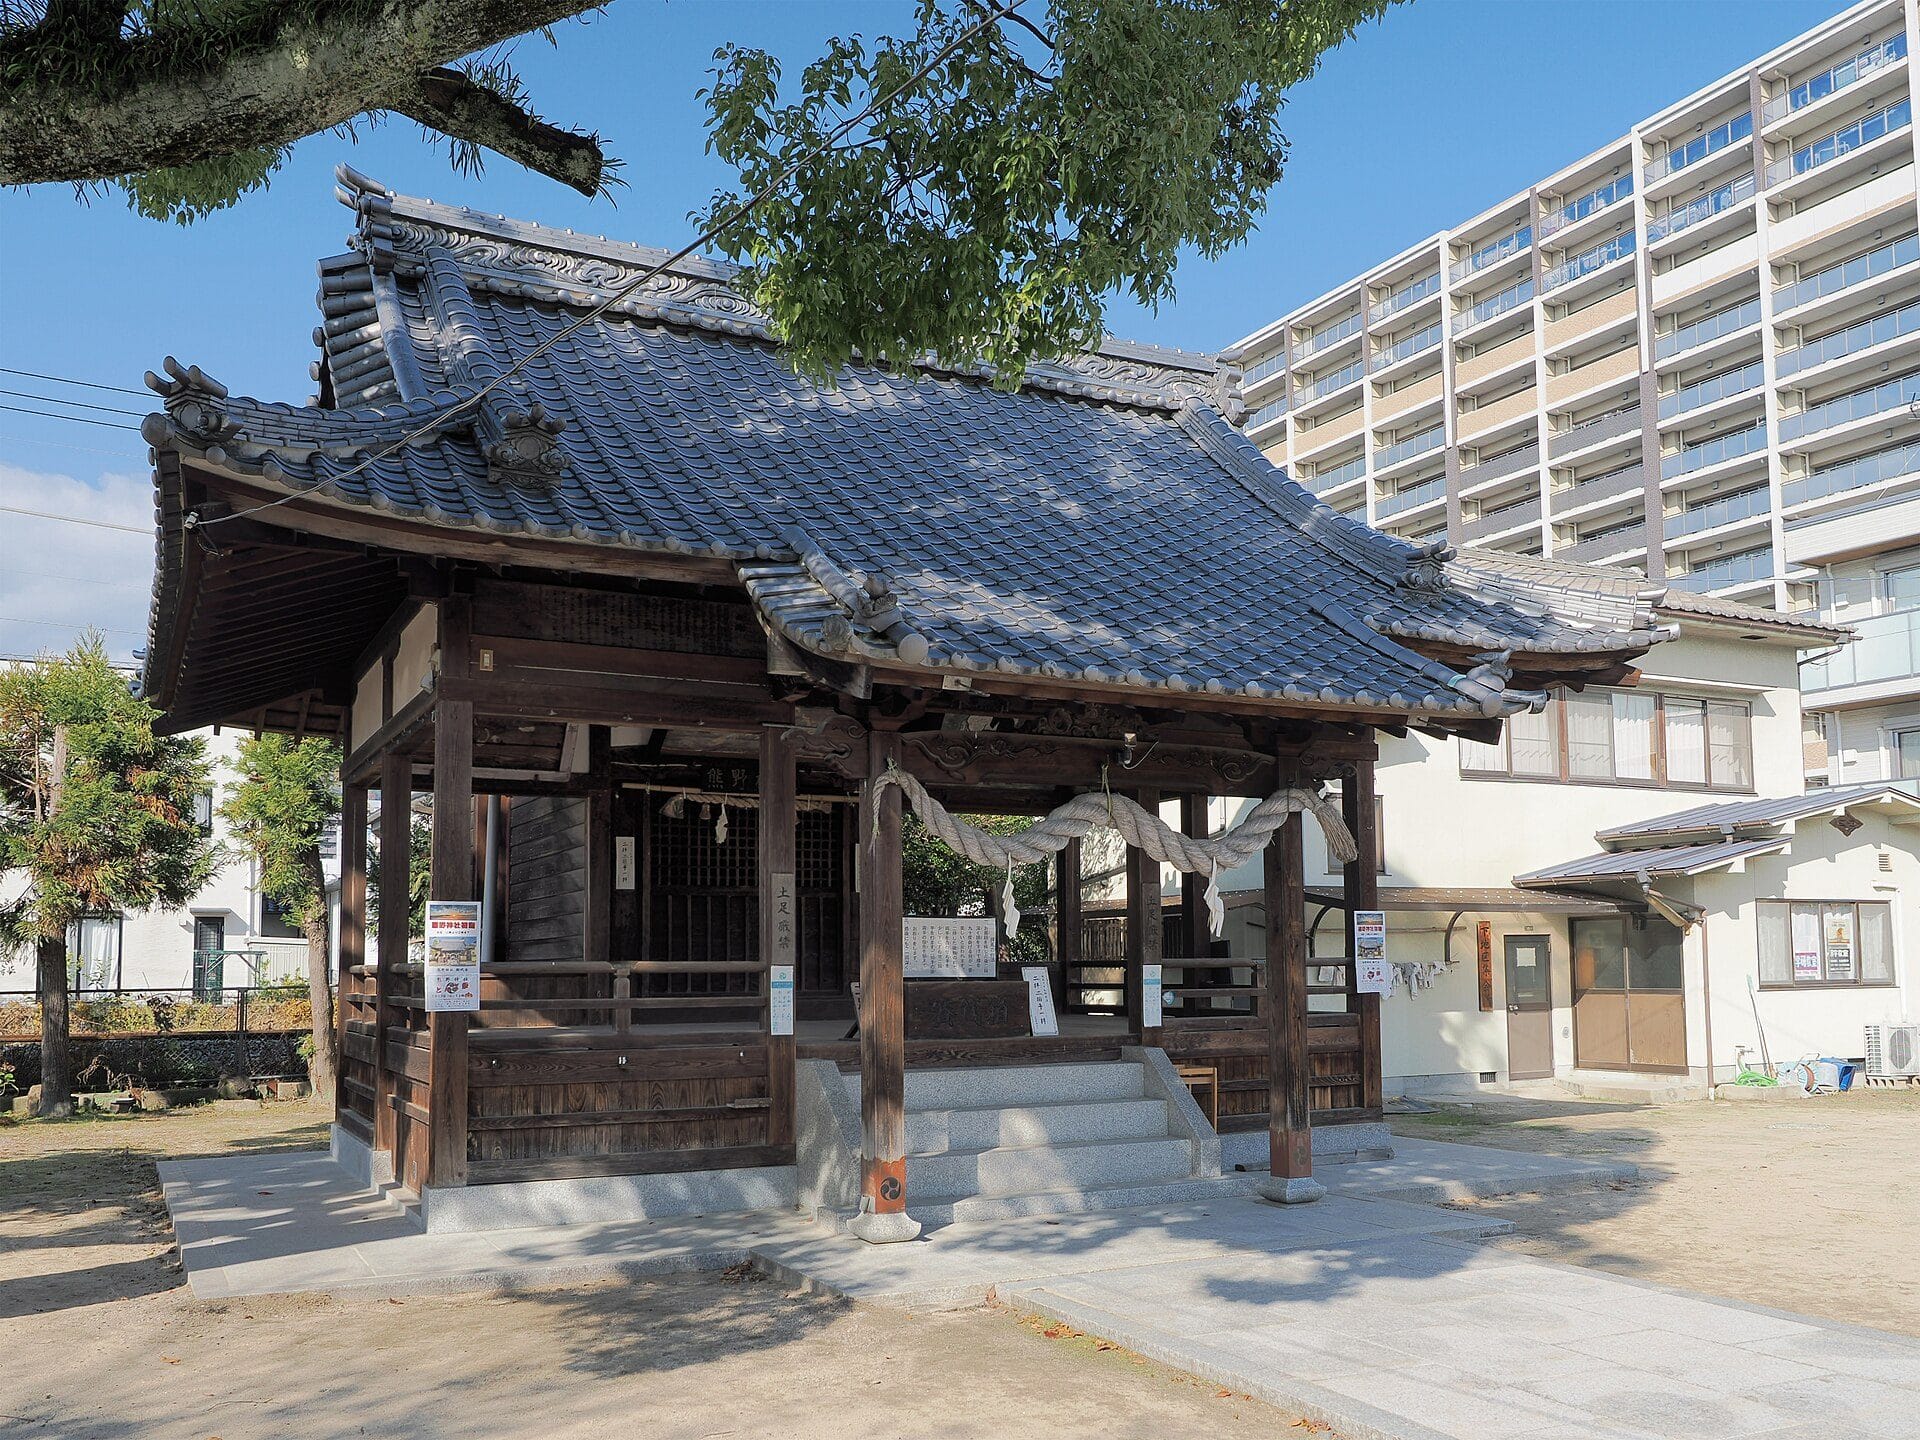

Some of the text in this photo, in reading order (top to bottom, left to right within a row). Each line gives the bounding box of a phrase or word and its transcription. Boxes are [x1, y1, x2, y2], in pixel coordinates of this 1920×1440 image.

[707, 767, 759, 790] 熊野
[776, 886, 791, 949] 土足厳禁
